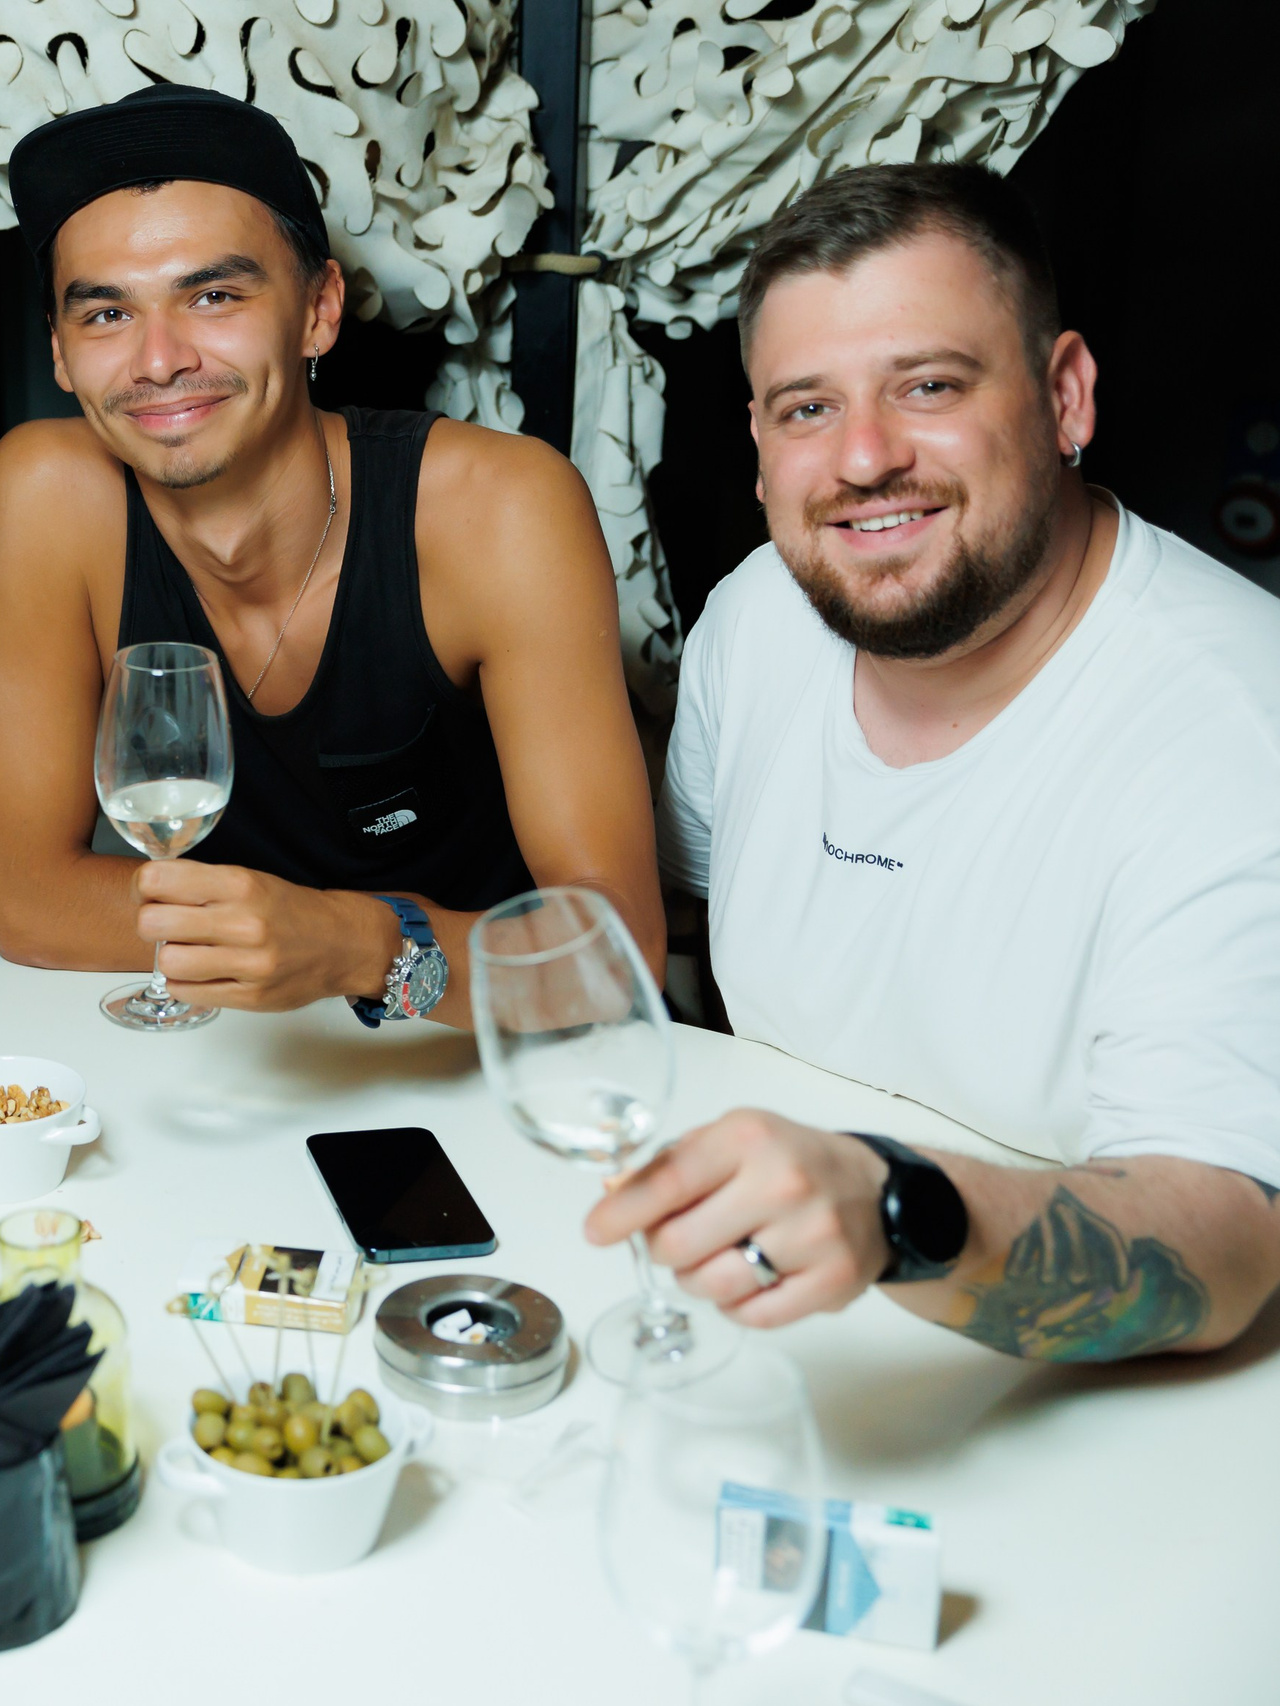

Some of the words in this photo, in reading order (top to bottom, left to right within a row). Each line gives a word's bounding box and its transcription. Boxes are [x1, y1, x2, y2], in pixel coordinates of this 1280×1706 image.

[375, 813, 396, 824] THE
[363, 818, 398, 834] NORTH
[375, 824, 400, 836] FACE
[823, 832, 896, 871] OCHROME
